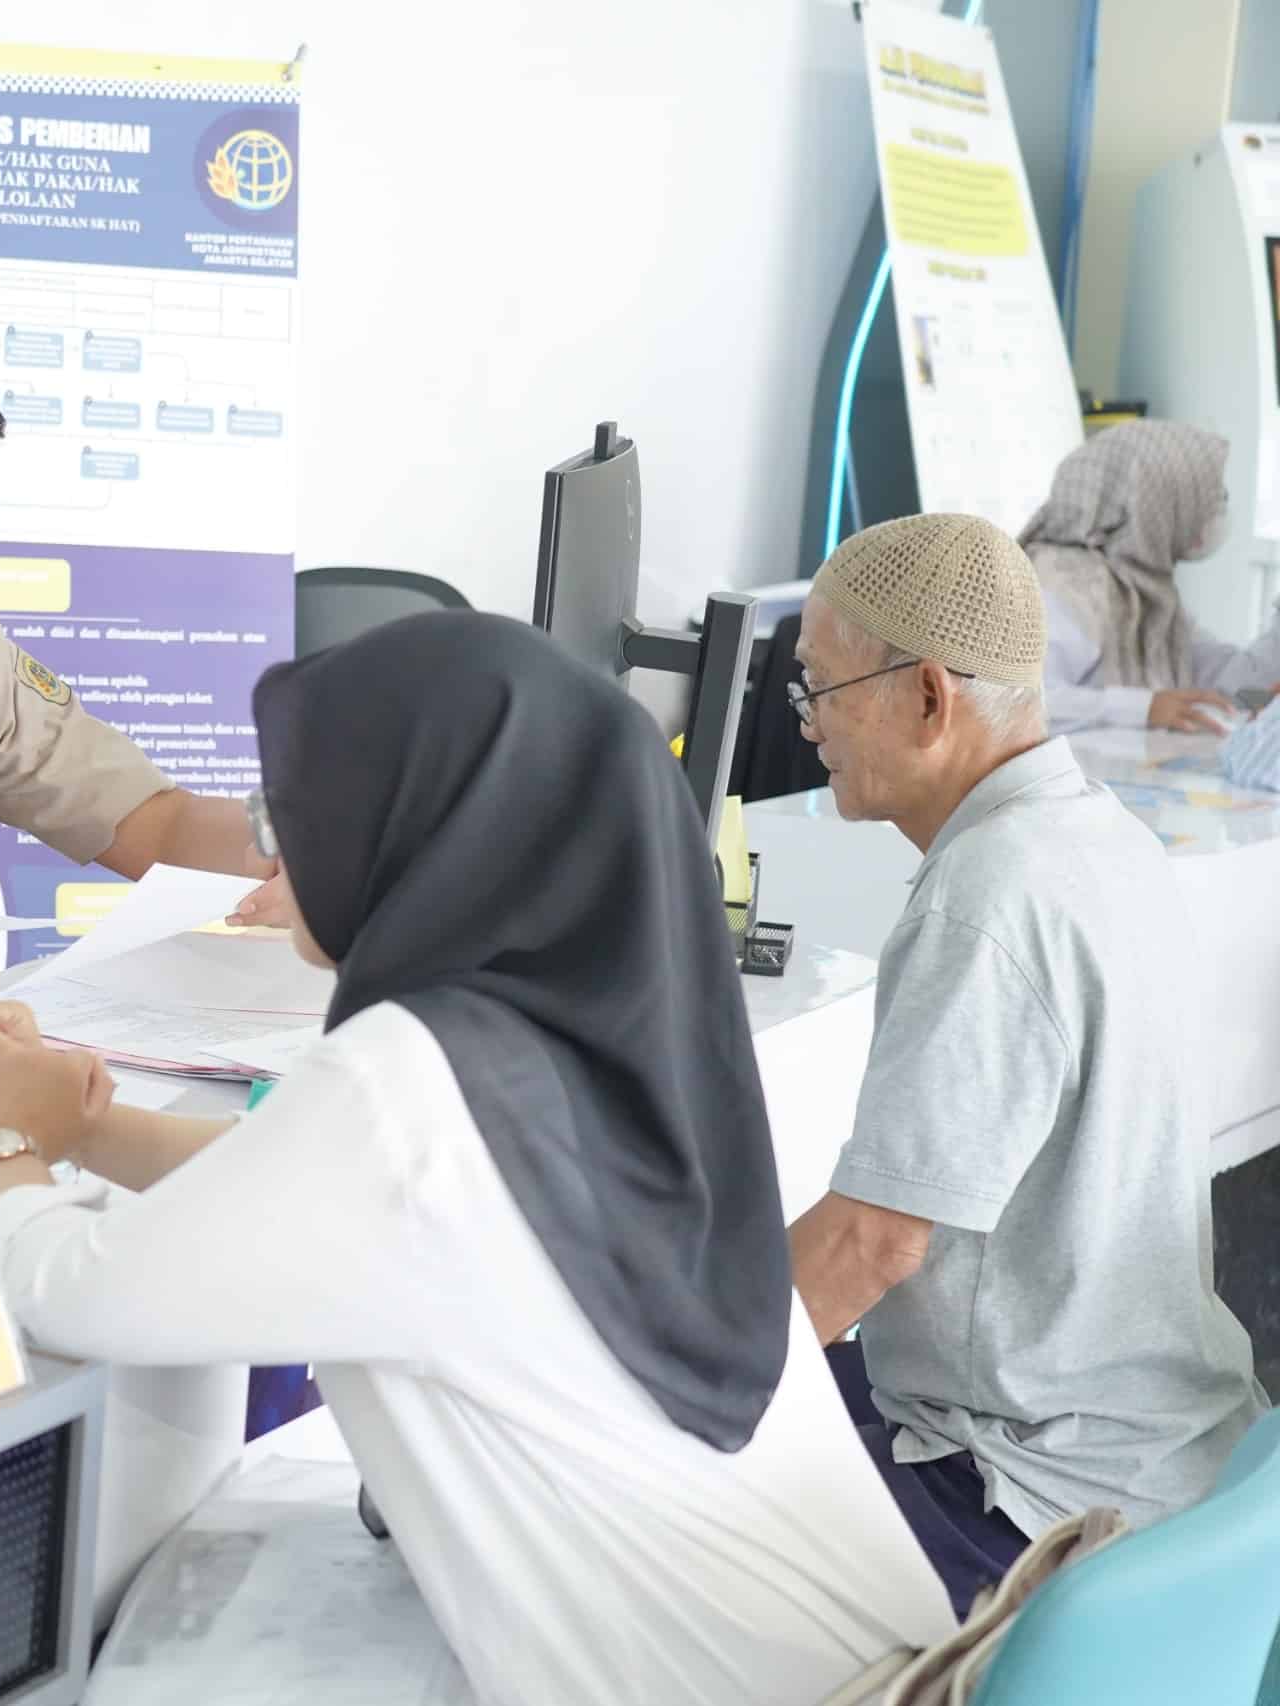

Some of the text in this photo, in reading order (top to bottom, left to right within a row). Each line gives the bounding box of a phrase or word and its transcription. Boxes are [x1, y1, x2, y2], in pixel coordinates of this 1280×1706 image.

[21, 117, 150, 153] PEMBERIAN
[57, 154, 111, 173] GUNA
[34, 171, 140, 194] PAKAI/HAK
[250, 256, 294, 268] SELATAN
